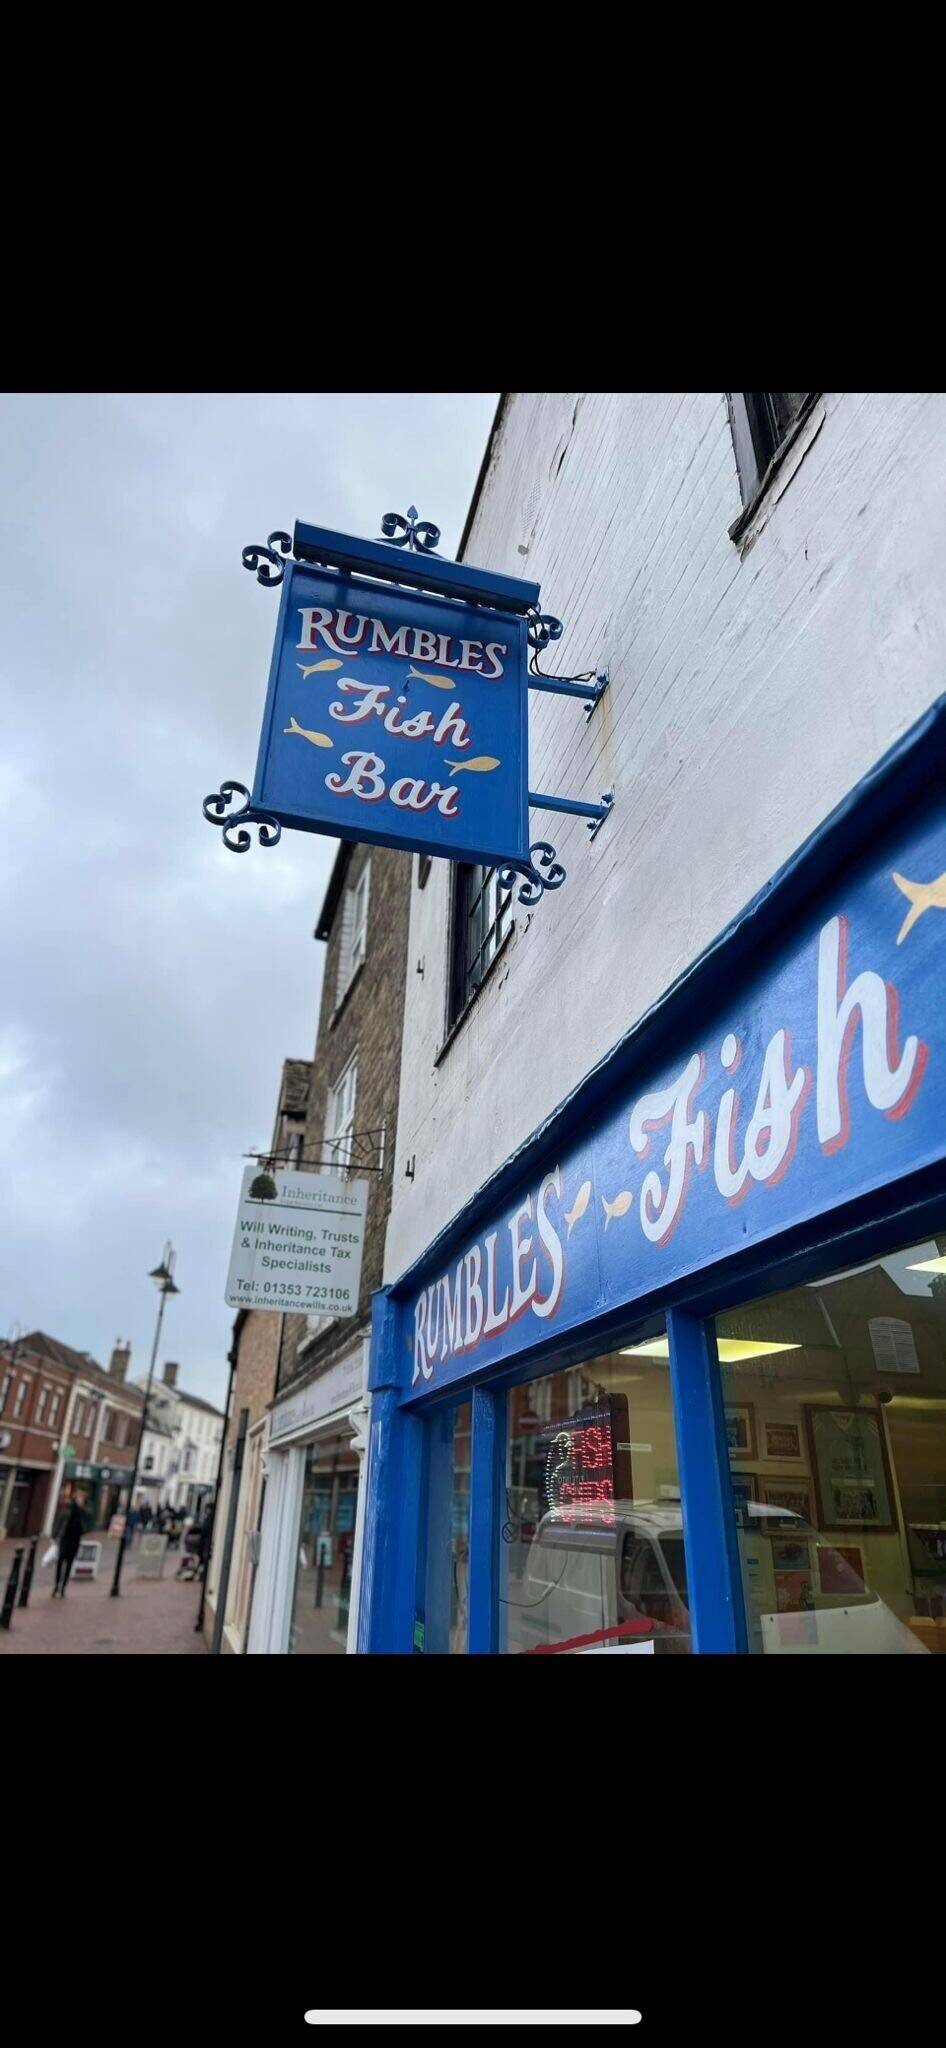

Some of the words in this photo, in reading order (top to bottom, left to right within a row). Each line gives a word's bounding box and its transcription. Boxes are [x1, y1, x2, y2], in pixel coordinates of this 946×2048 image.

[296, 607, 508, 679] RUMBLES
[328, 677, 470, 748] Fish
[324, 751, 461, 816] Bar
[410, 1165, 566, 1386] RUMBLES
[629, 914, 928, 1246] Fish
[281, 1185, 358, 1206] Inheritance
[240, 1220, 264, 1233] Will
[268, 1224, 317, 1241] Writing,
[321, 1229, 360, 1244] Trusts
[241, 1237, 250, 1249] &
[254, 1238, 326, 1257] Inheritance
[330, 1247, 351, 1259] Tax
[261, 1256, 332, 1273] Specialists
[236, 1279, 260, 1292] Tel:
[263, 1282, 302, 1296] 01353
[305, 1285, 350, 1300] 723106
[229, 1294, 352, 1312] www.inheritancewills.co.uk
